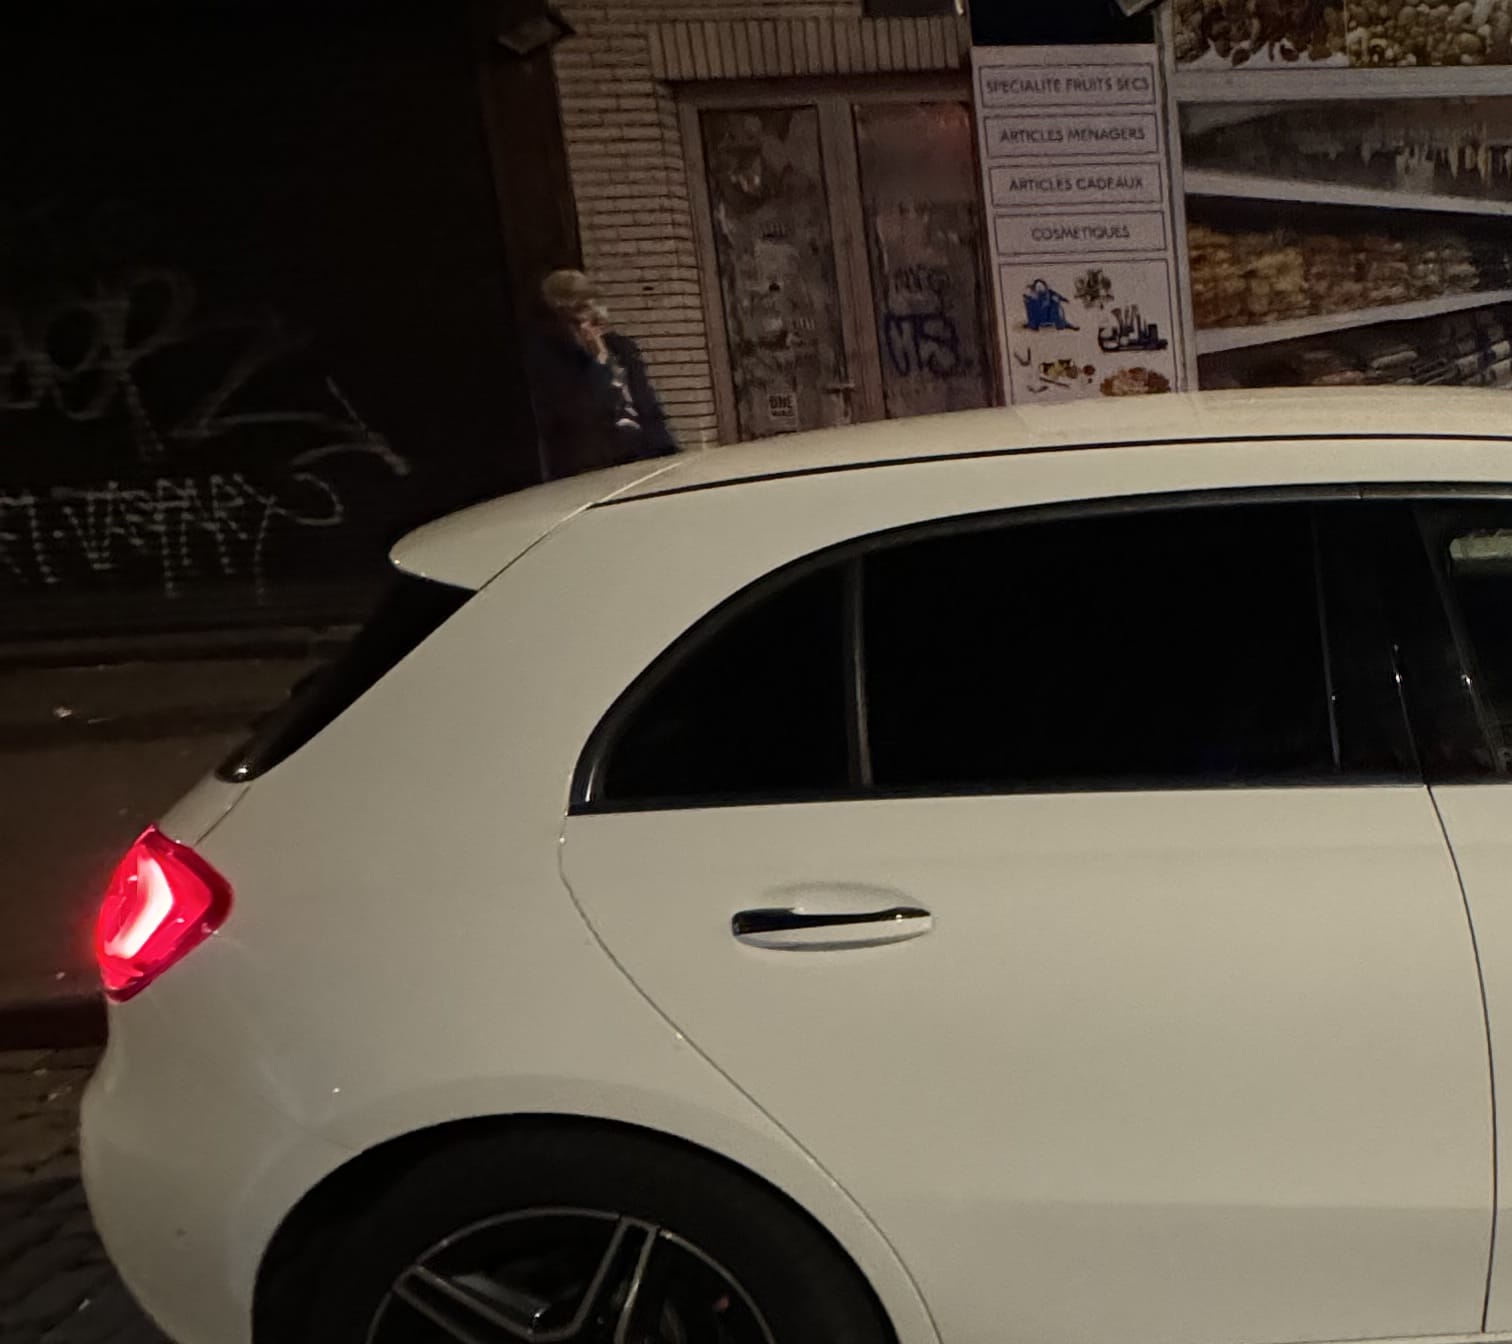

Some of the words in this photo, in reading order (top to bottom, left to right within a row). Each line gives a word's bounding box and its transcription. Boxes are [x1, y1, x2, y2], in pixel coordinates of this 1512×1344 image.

[1065, 77, 1113, 93] FRUITS
[1116, 77, 1150, 92] SECS
[999, 128, 1065, 144] ARTICLES
[1066, 127, 1146, 144] MENAGERS
[1008, 177, 1074, 193] ARTICLES
[1075, 176, 1144, 191] CADEAUX
[1030, 224, 1131, 242] COSMETIQUES
